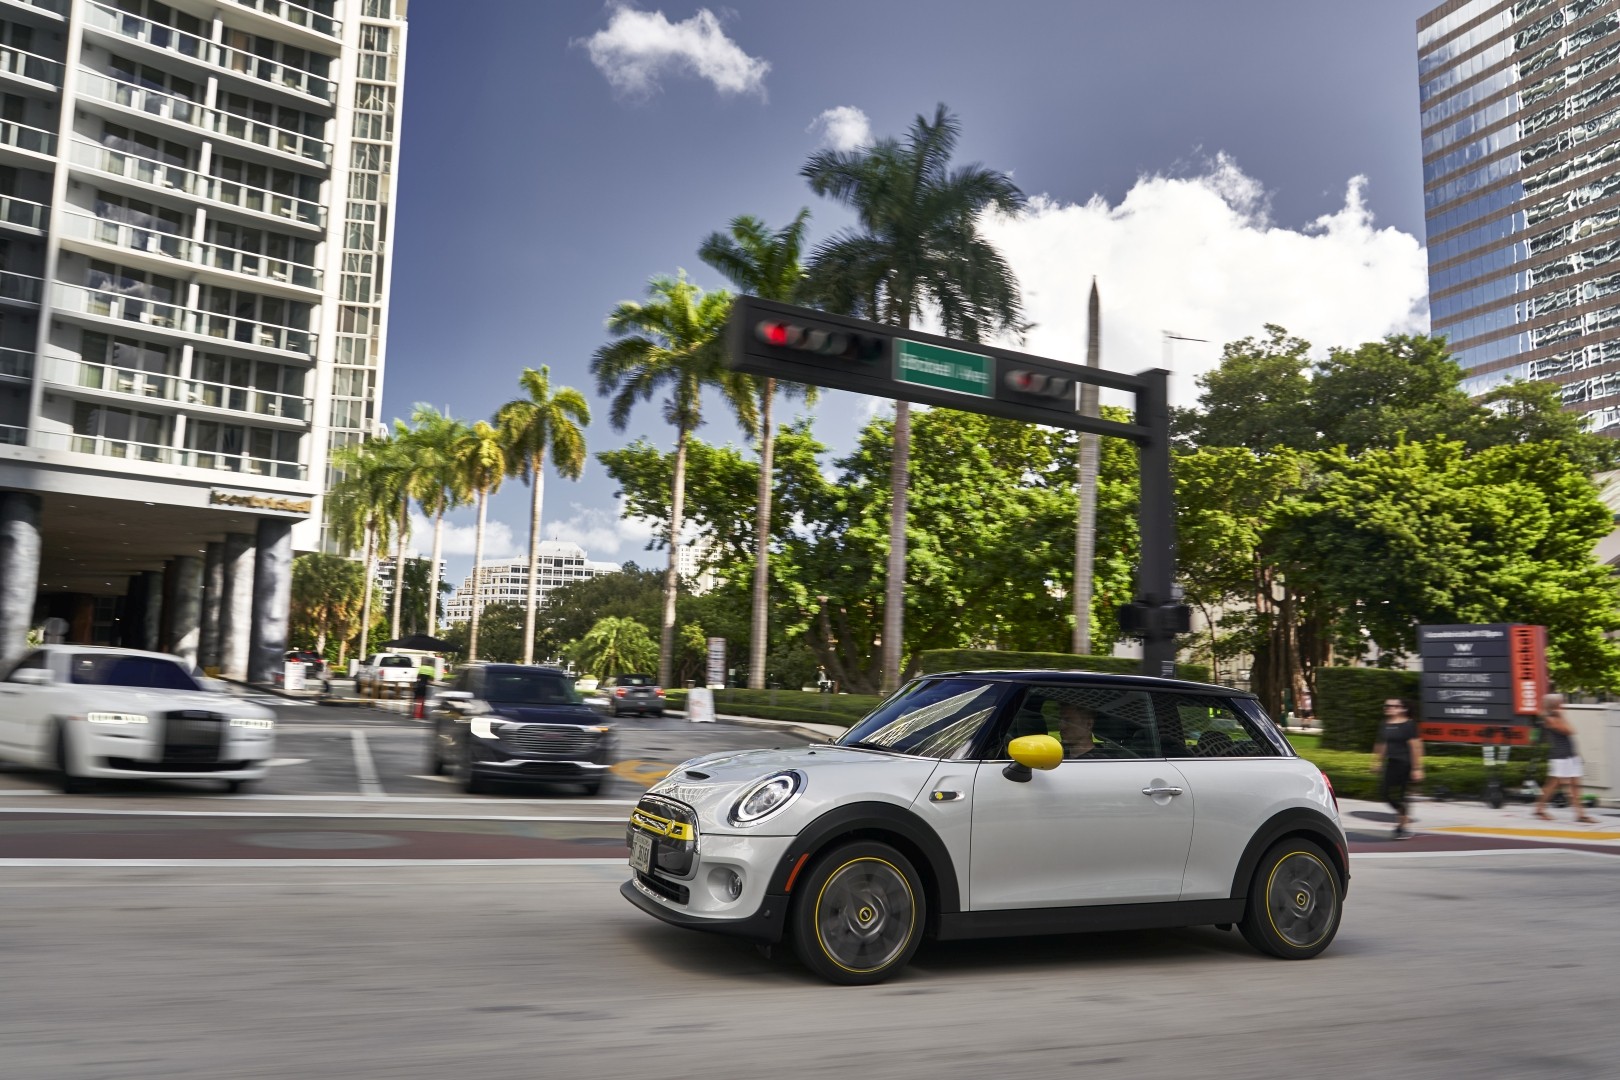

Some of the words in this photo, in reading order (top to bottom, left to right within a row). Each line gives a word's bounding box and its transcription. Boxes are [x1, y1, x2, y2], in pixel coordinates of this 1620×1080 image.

[899, 352, 955, 378] Brickell
[957, 366, 990, 384] Ave
[1515, 629, 1534, 680] brickell
